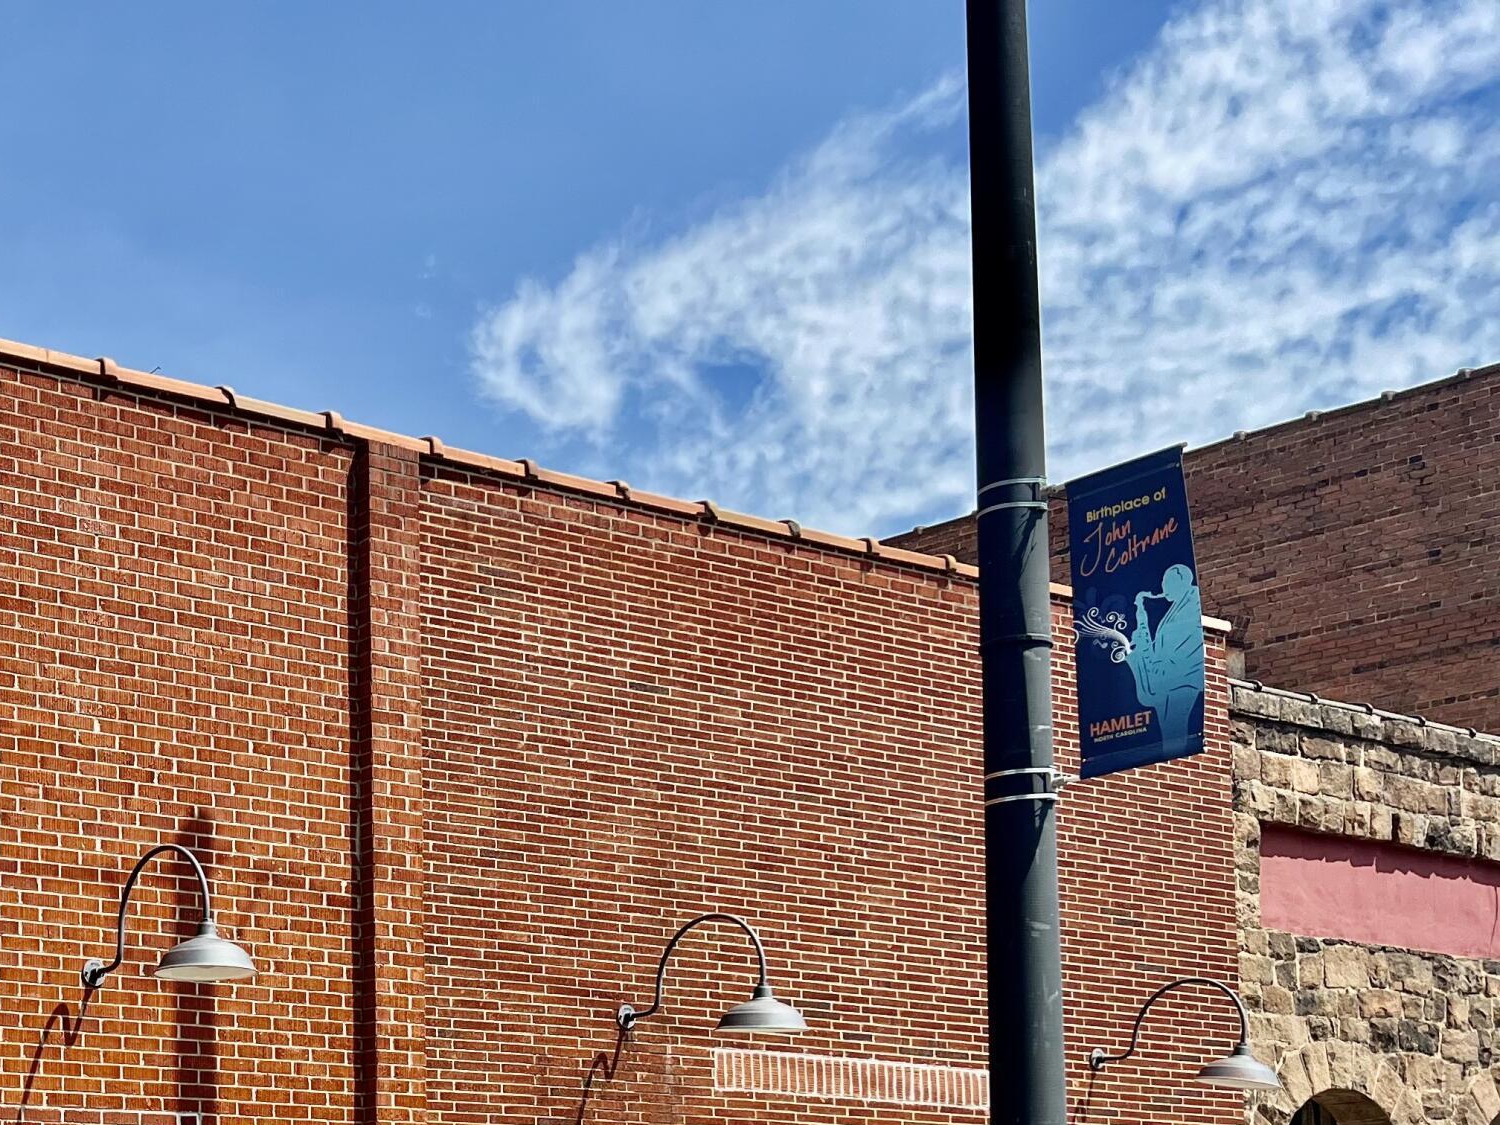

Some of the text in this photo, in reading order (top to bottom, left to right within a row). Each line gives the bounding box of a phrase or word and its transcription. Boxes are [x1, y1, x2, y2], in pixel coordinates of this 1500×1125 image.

[1086, 486, 1166, 523] Birthplace of
[1080, 520, 1131, 577] John
[1105, 517, 1179, 573] Coltrane
[1090, 710, 1152, 737] HAMLET
[1093, 726, 1148, 743] NORTH CAROLINA
